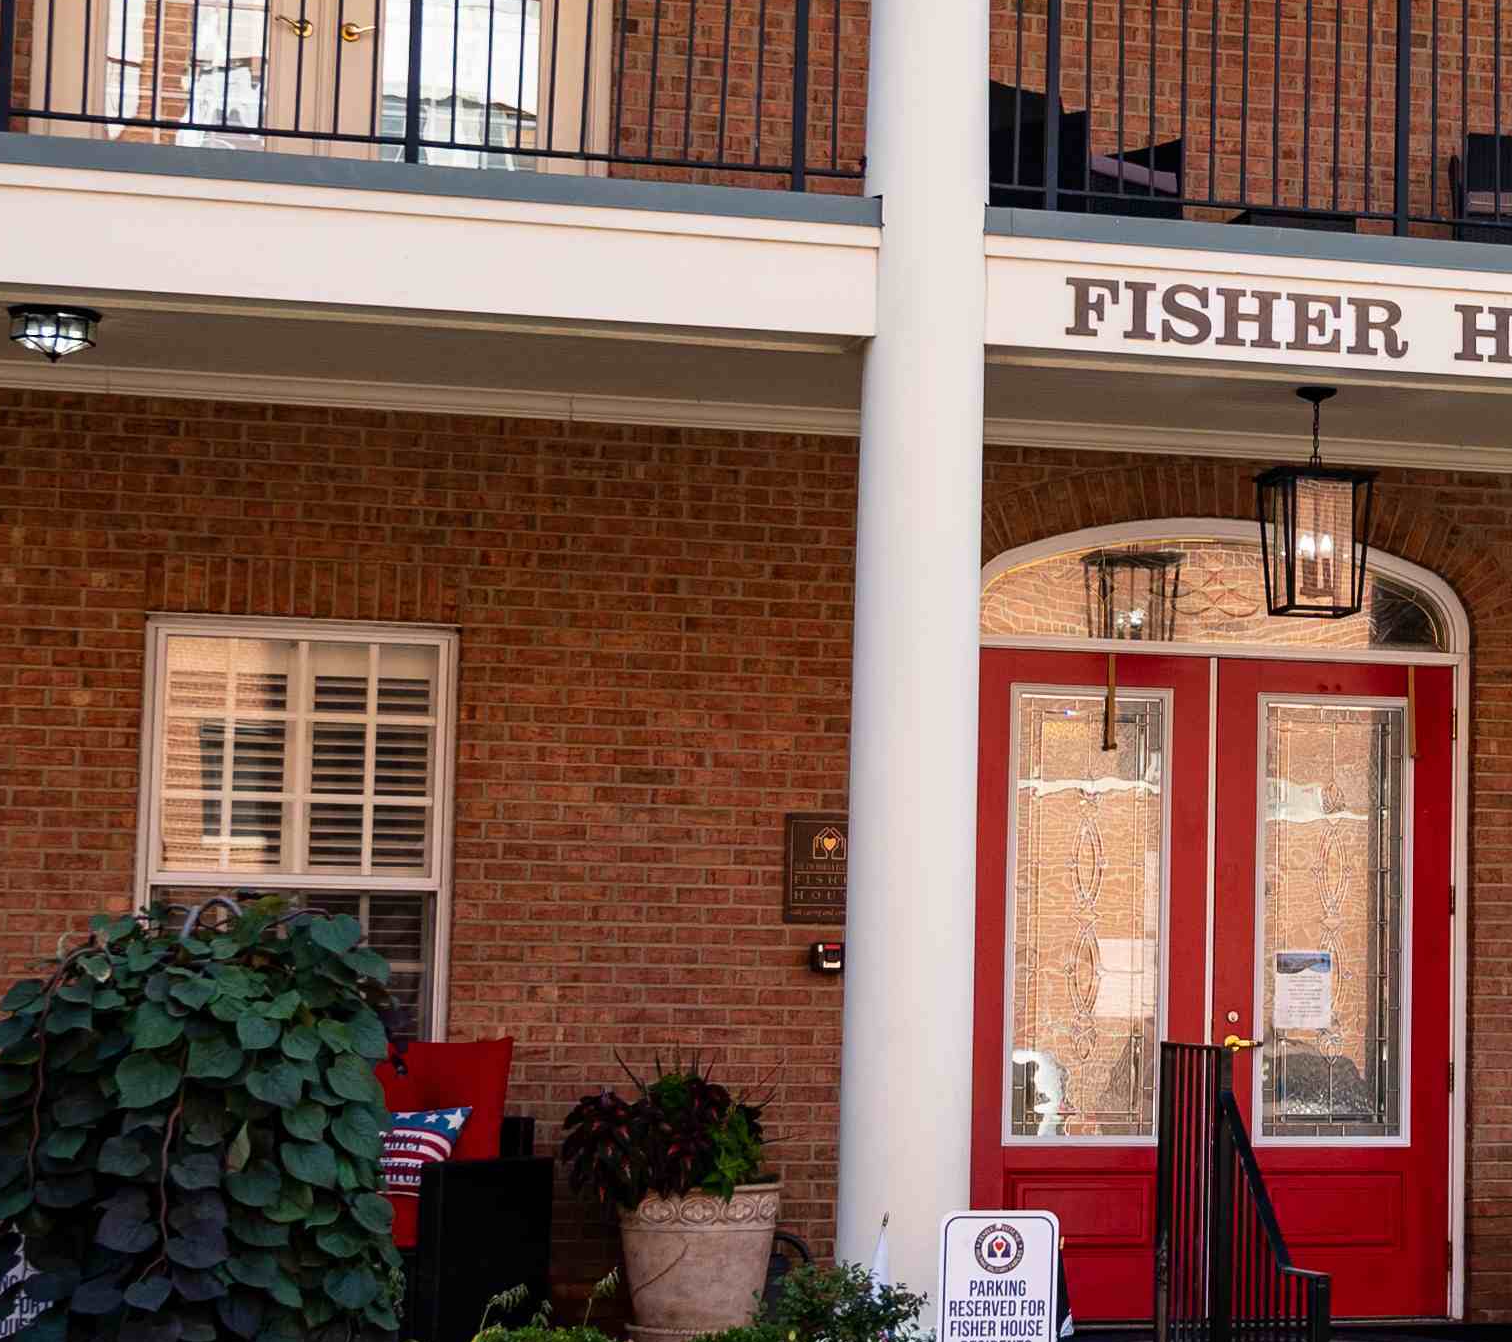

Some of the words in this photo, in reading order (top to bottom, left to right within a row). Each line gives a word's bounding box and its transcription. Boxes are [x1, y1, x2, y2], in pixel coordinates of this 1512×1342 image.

[1065, 276, 1408, 358] FISHER
[794, 874, 846, 884] FISH
[969, 1279, 1027, 1297] PARKING
[949, 1300, 1016, 1317] RESERVED
[1020, 1300, 1046, 1316] FOR
[950, 1320, 996, 1337] FISHER
[1000, 1319, 1043, 1337] HOUSE
